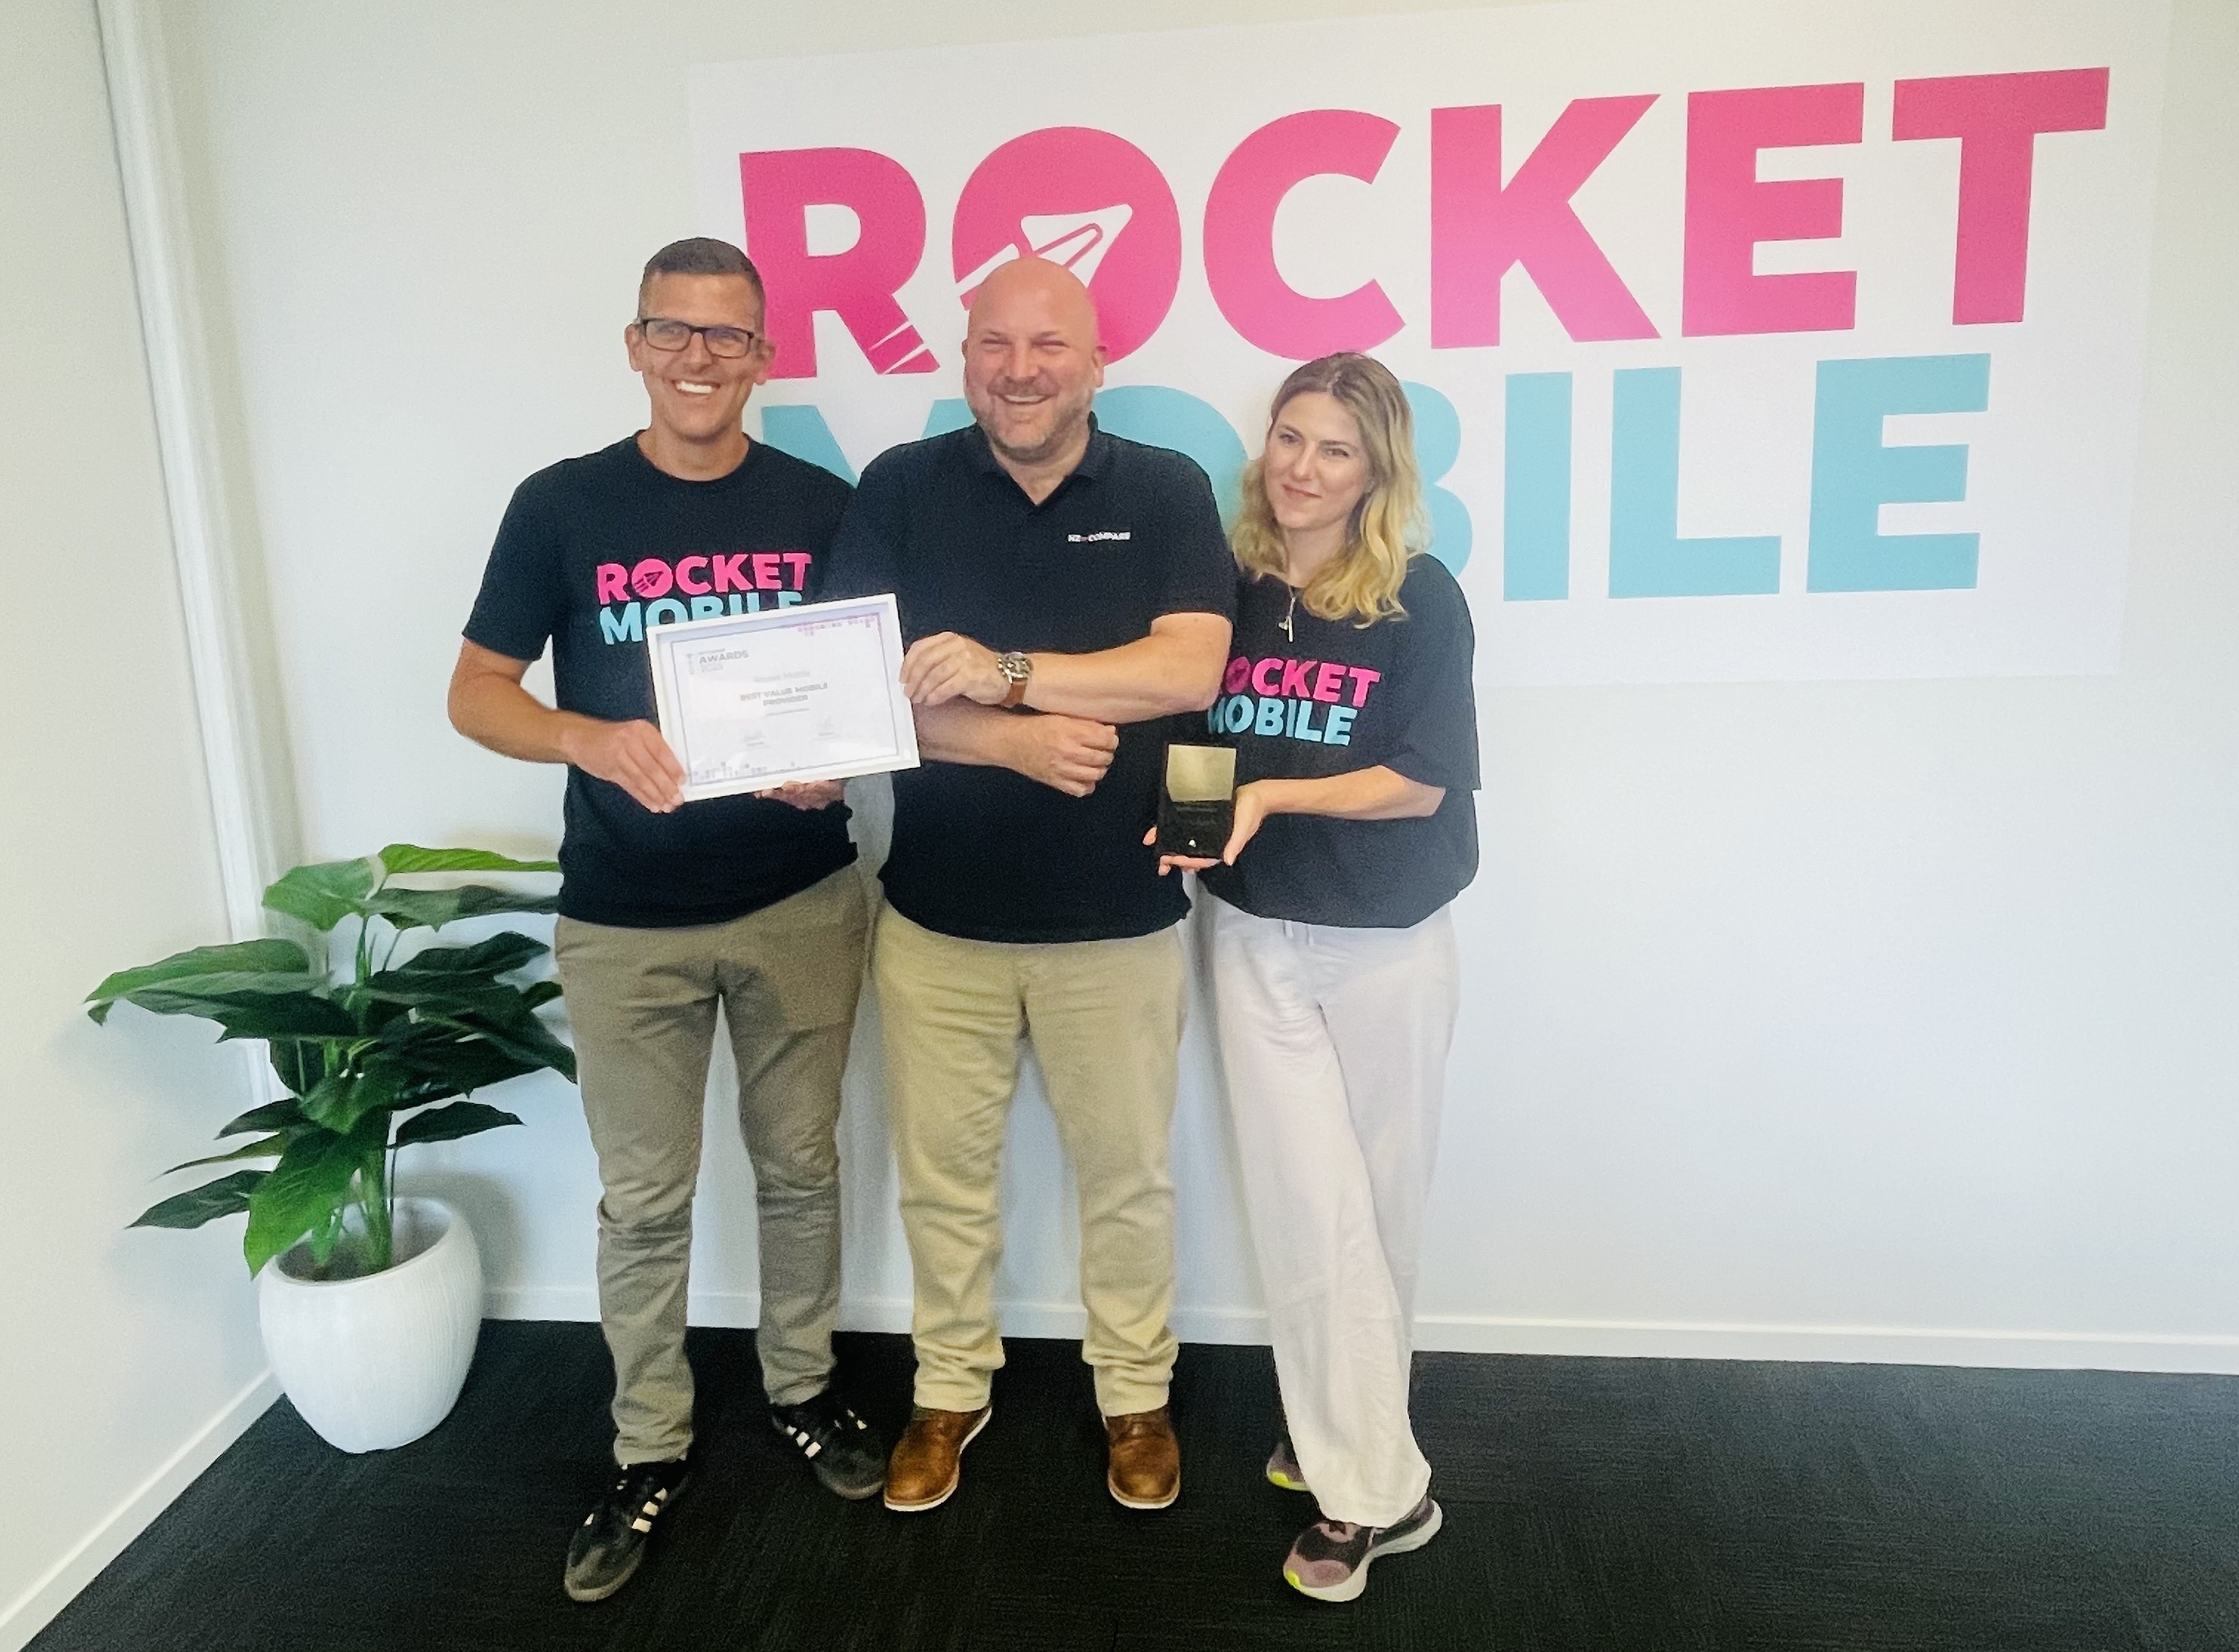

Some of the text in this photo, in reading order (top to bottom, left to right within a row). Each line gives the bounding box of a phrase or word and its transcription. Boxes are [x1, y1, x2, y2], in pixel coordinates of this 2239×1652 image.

[739, 67, 2109, 380] ROCKET
[761, 353, 1991, 601] ILE
[596, 552, 812, 605] ROCKET
[699, 650, 749, 663] AWARDS
[1224, 656, 1382, 708] OCKET
[1208, 695, 1358, 746] MOBILE
